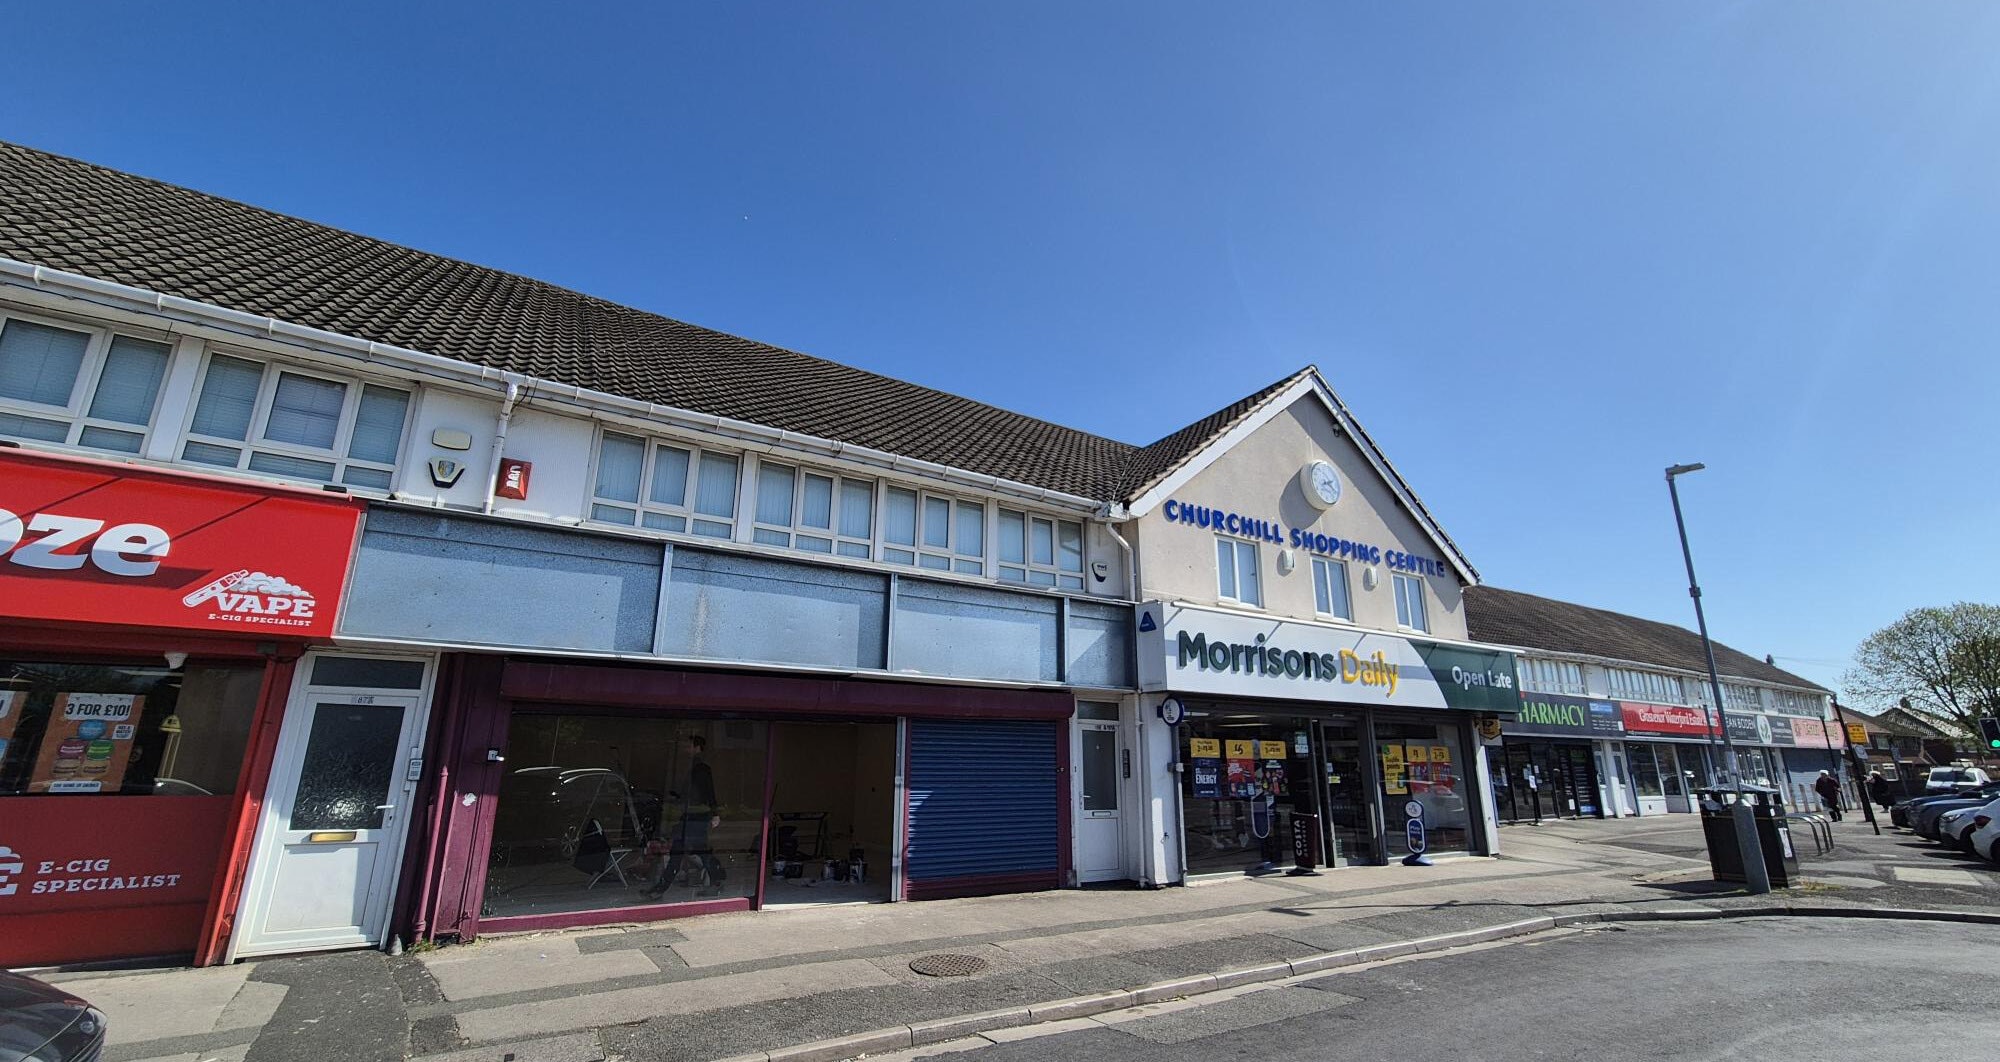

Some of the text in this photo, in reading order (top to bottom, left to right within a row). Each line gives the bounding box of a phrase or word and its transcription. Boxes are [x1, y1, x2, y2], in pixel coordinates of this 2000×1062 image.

[1163, 499, 1446, 578] CHURCHILL SHOPPING CENTRE
[216, 592, 315, 618] VAPE
[208, 613, 312, 627] E-CIG SPECIALIST
[1177, 629, 1399, 697] Morrisons Daily
[1451, 665, 1512, 690] Open Late
[65, 703, 132, 716] 3 FOR £10!
[1518, 701, 1585, 727] HARMACY
[1195, 774, 1217, 784] ENERGY
[37, 859, 111, 874] E-CIG
[31, 874, 181, 895] SPECIALIST
